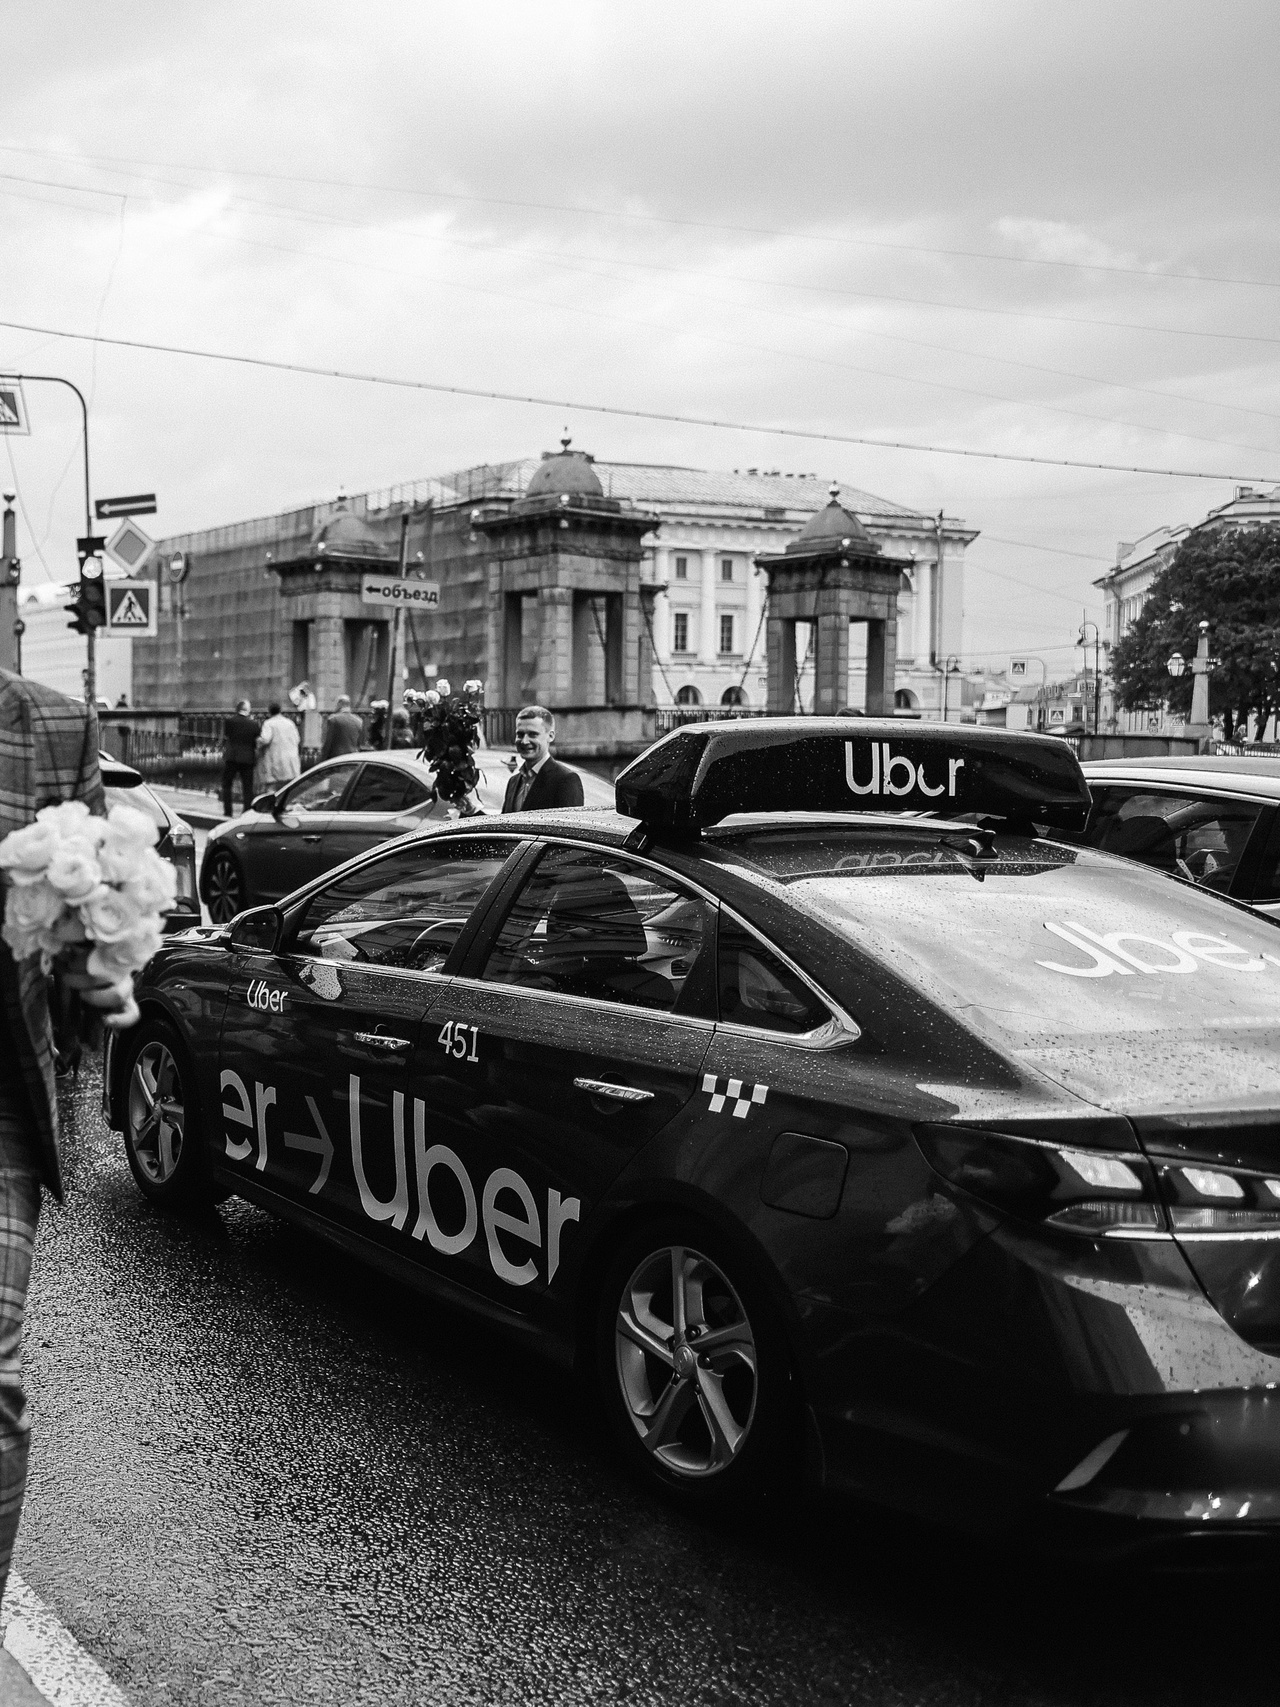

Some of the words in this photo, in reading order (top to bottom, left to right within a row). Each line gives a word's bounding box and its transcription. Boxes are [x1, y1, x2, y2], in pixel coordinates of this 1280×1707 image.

[382, 584, 437, 603] объезд
[247, 979, 288, 1012] Uber
[438, 1020, 479, 1062] 451
[349, 1073, 580, 1287] Uber
